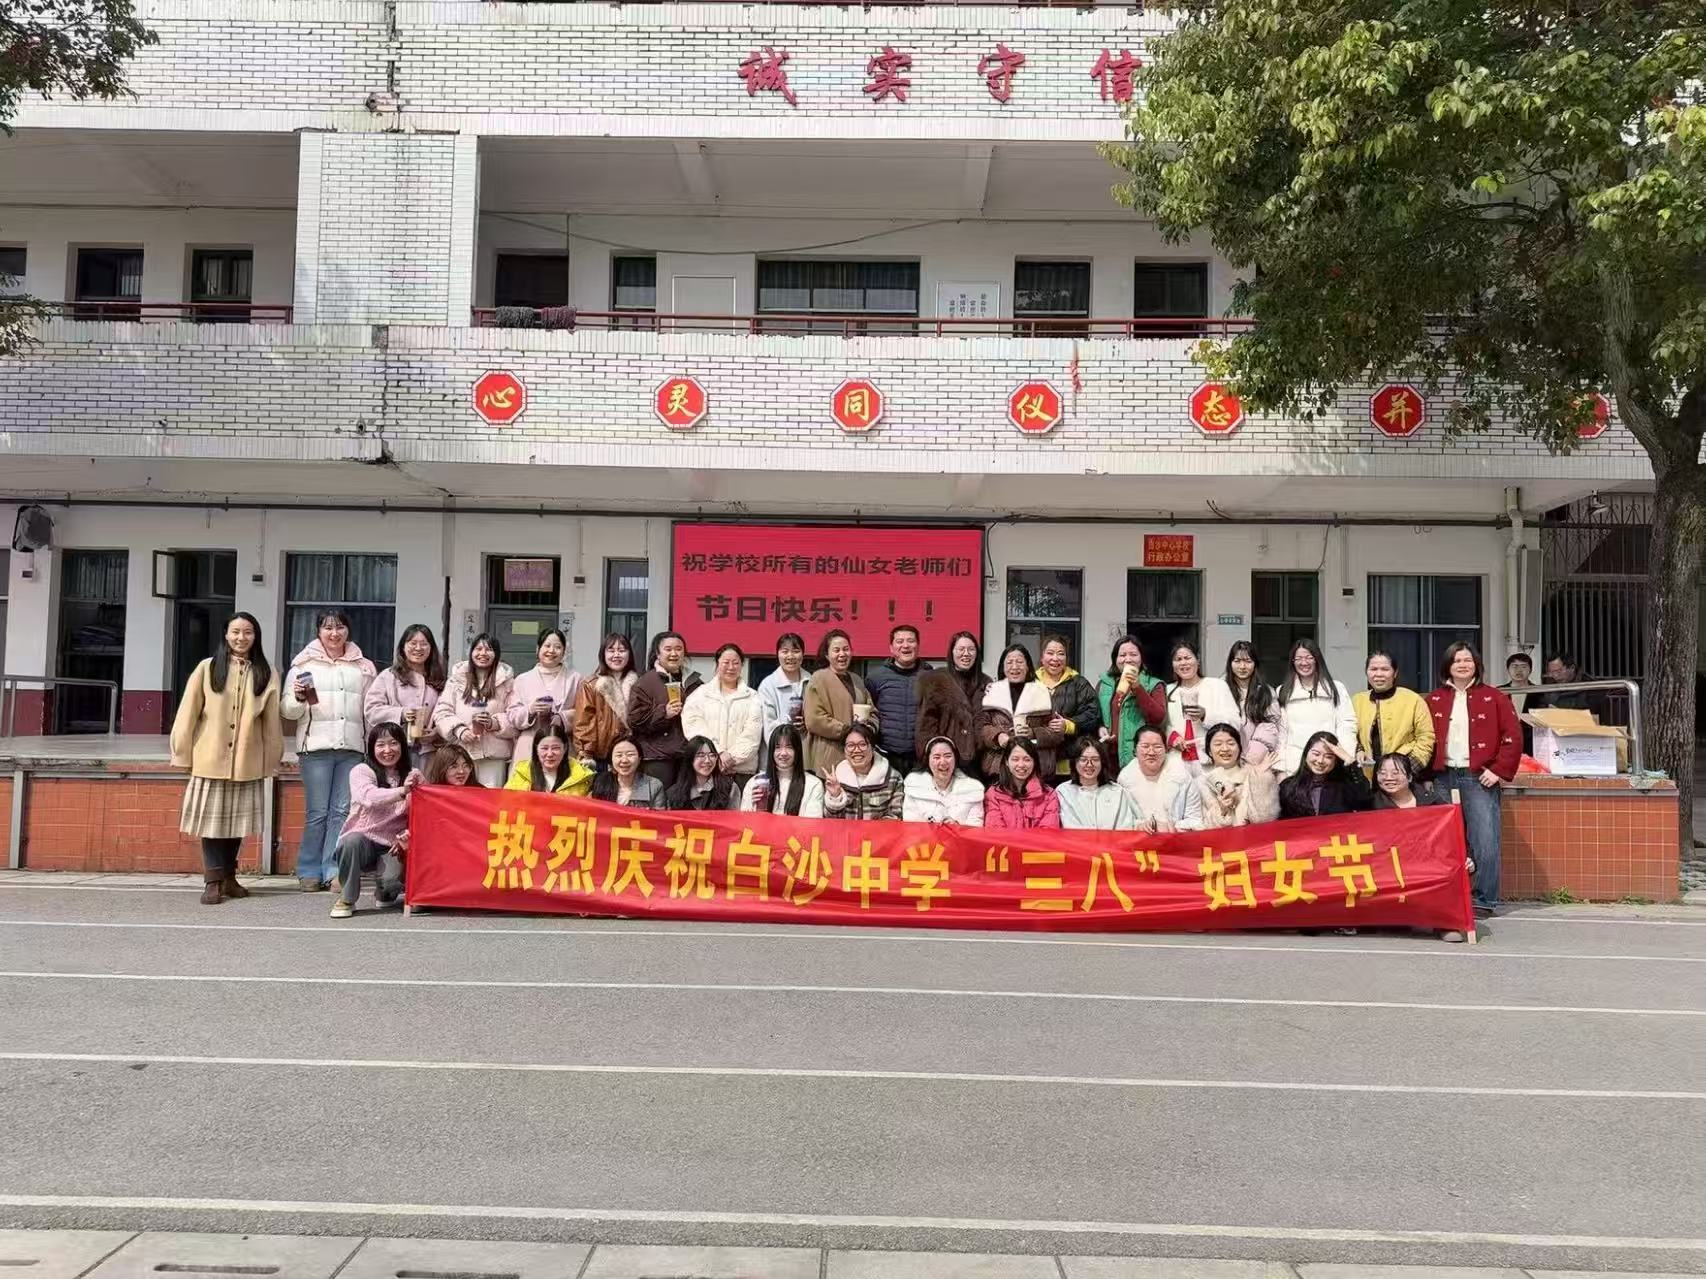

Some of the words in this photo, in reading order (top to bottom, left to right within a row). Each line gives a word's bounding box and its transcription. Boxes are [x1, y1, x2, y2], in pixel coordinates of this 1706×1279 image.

[483, 386, 516, 408] 心
[665, 383, 697, 417] 灵
[844, 388, 870, 421] 同
[1016, 392, 1053, 424] 仪
[1200, 389, 1232, 426] 态
[682, 552, 972, 577] 祝学校所有的仙女老师们
